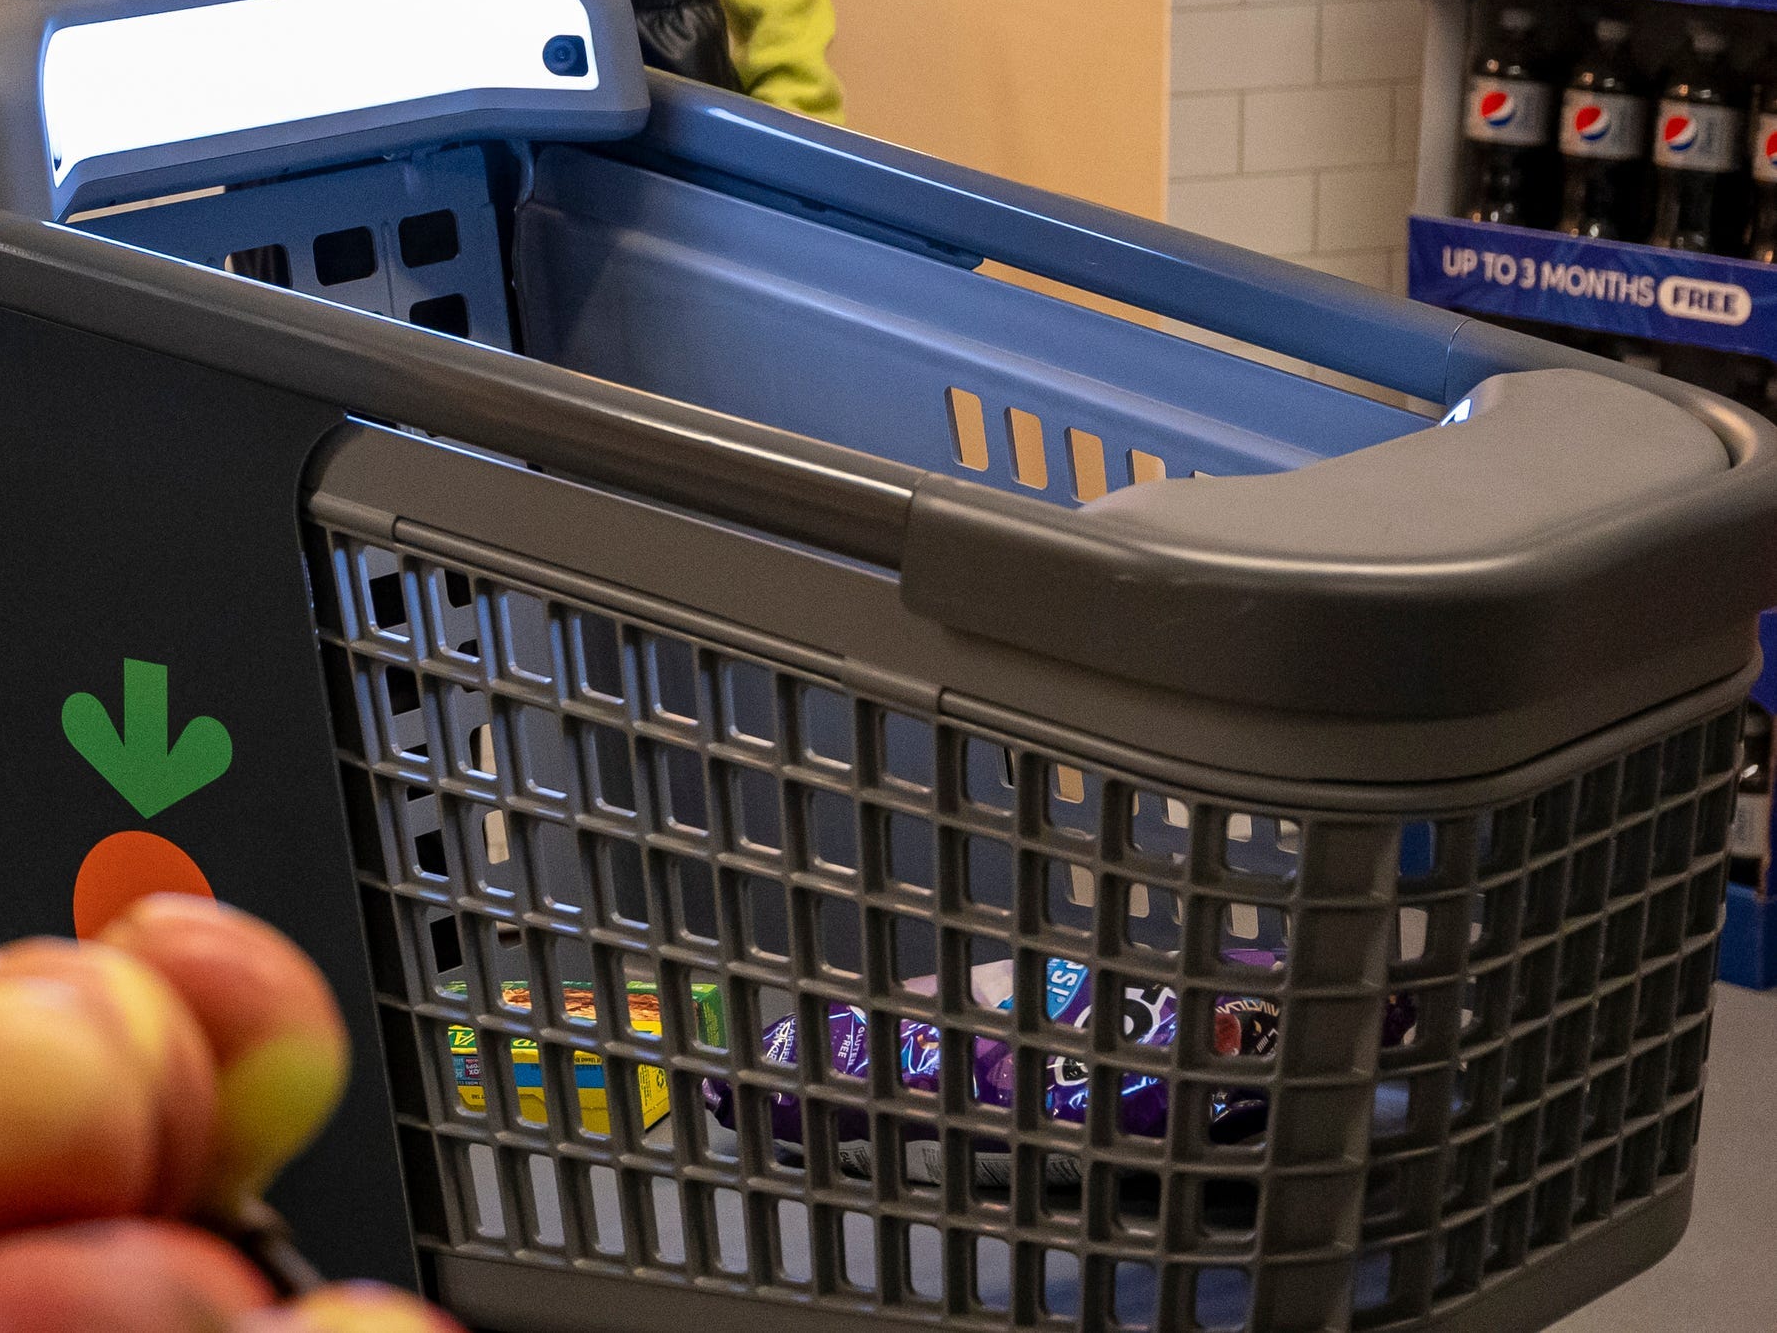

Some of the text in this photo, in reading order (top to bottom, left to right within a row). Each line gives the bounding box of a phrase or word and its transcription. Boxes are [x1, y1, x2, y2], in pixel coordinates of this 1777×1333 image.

[1441, 245, 1739, 315] UP TO 3 MONTHS FREE
[837, 1034, 852, 1059] FREE
[847, 1026, 866, 1067] GLUTEN
